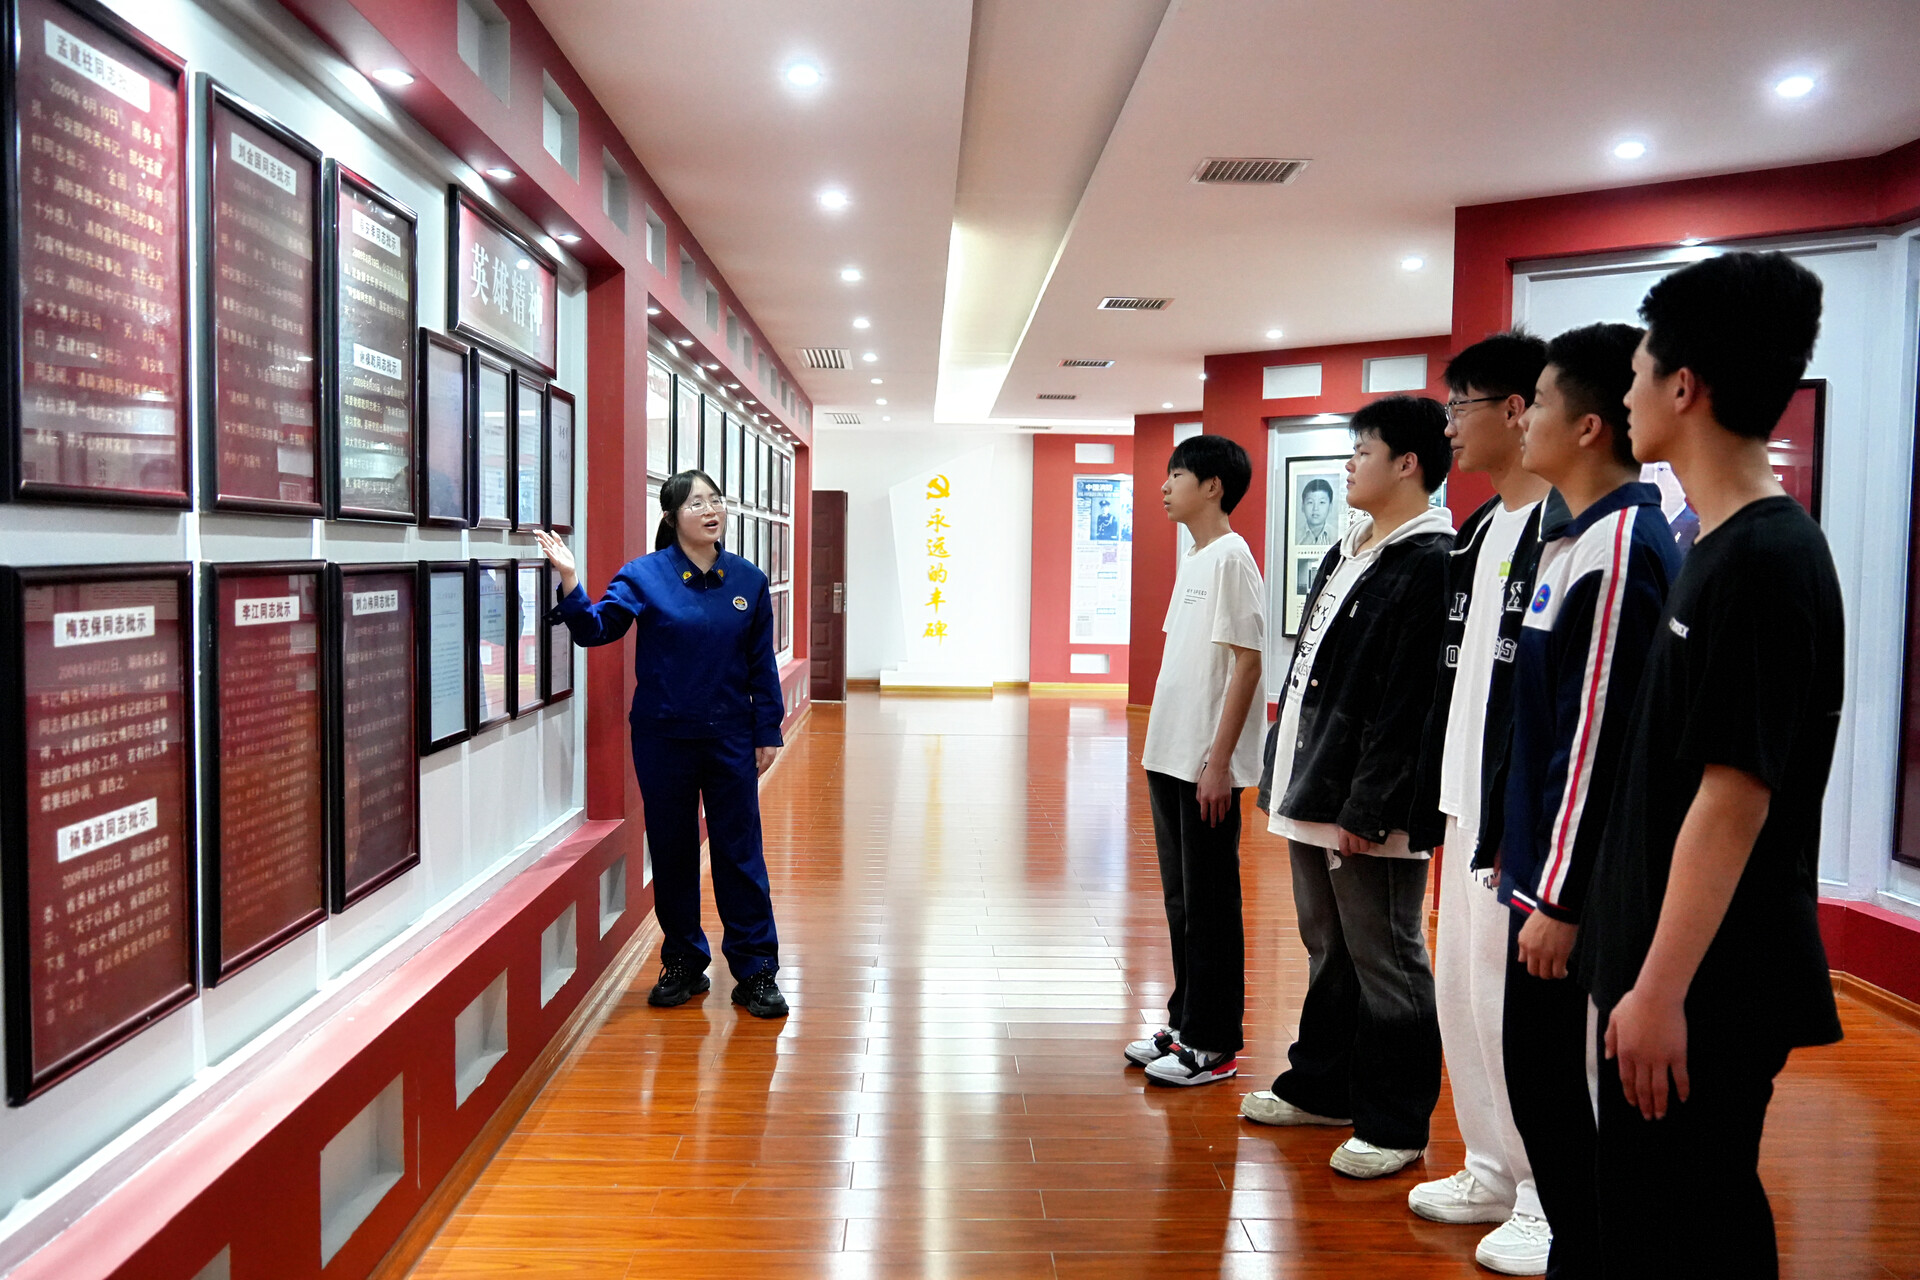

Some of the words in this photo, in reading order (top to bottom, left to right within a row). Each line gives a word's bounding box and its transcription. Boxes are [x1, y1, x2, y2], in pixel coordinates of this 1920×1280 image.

[238, 142, 290, 188] 刘金国同志批示
[471, 242, 543, 336] 英雄精神
[922, 507, 951, 646] 永远的丰碑
[66, 611, 147, 640] 梅克保同志批示
[242, 601, 291, 620] 李江同志批示
[69, 806, 148, 851] 杨泰波同志批示
